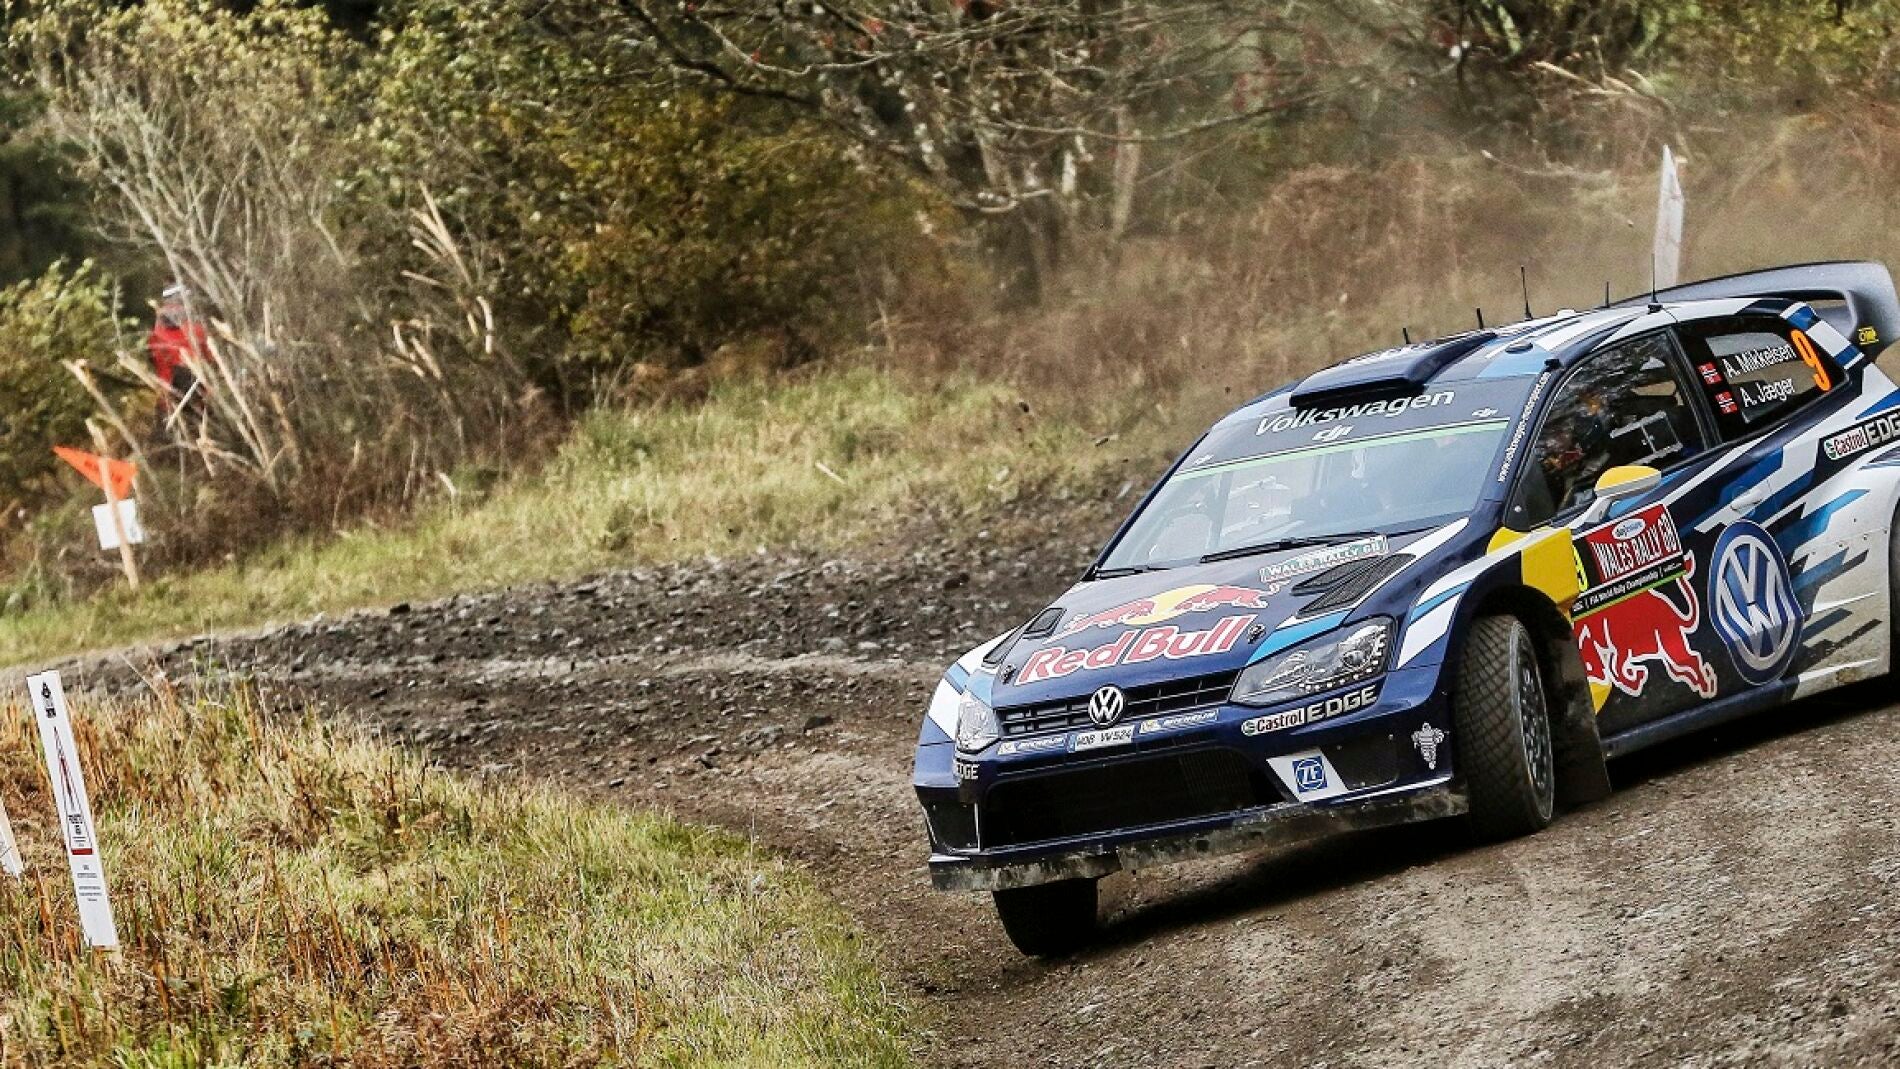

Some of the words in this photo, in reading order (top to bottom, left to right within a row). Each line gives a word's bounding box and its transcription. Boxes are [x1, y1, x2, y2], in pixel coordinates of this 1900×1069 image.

[1722, 358, 1740, 378] A.
[1735, 343, 1797, 373] Mikkelsen
[1790, 329, 1832, 392] 9
[1255, 389, 1455, 437] Volkswagen
[1740, 386, 1758, 407] A.
[1833, 428, 1866, 456] Castrol
[1864, 412, 1900, 446] EDG
[1590, 541, 1634, 579] WALES
[1630, 523, 1664, 566] RALLY
[1016, 630, 1136, 686] Red
[1122, 614, 1259, 661] Bull
[1256, 707, 1304, 732] Castrol
[1306, 684, 1377, 723] EDGE
